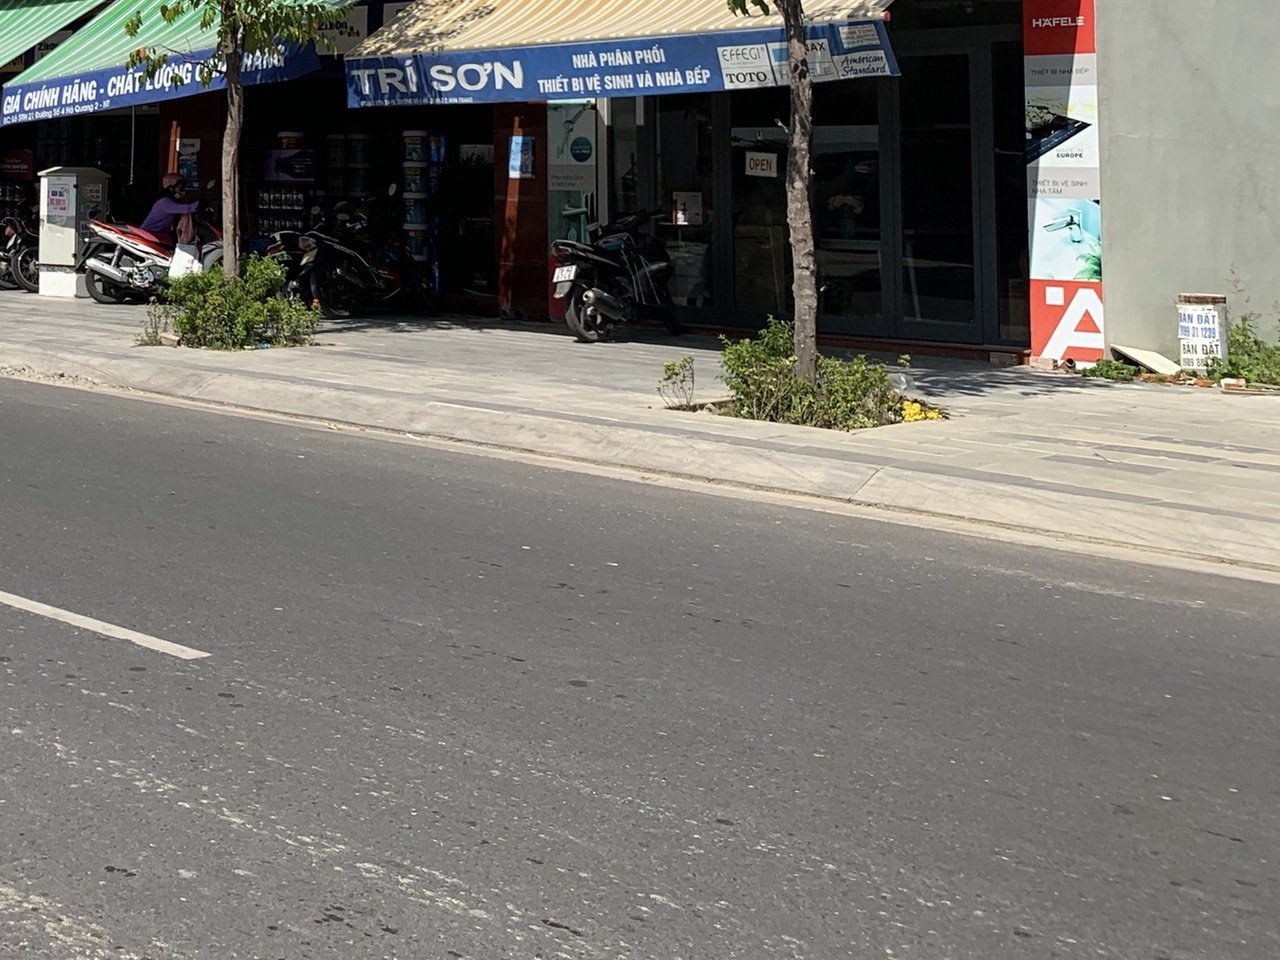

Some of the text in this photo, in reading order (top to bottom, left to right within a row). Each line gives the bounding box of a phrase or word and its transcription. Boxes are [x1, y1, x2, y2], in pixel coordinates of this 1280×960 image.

[571, 41, 667, 70] NHÀ PHÂN PHỐI
[3, 66, 144, 115] GIÁ CHÍNH HÃNG CHẤT
[351, 59, 524, 95] TRÍ SƠN
[537, 63, 712, 96] THIẾT BỊ VỆ SINH VÀ NHÀ BẾP
[726, 70, 767, 84] TOTO
[749, 157, 773, 172] OPEN
